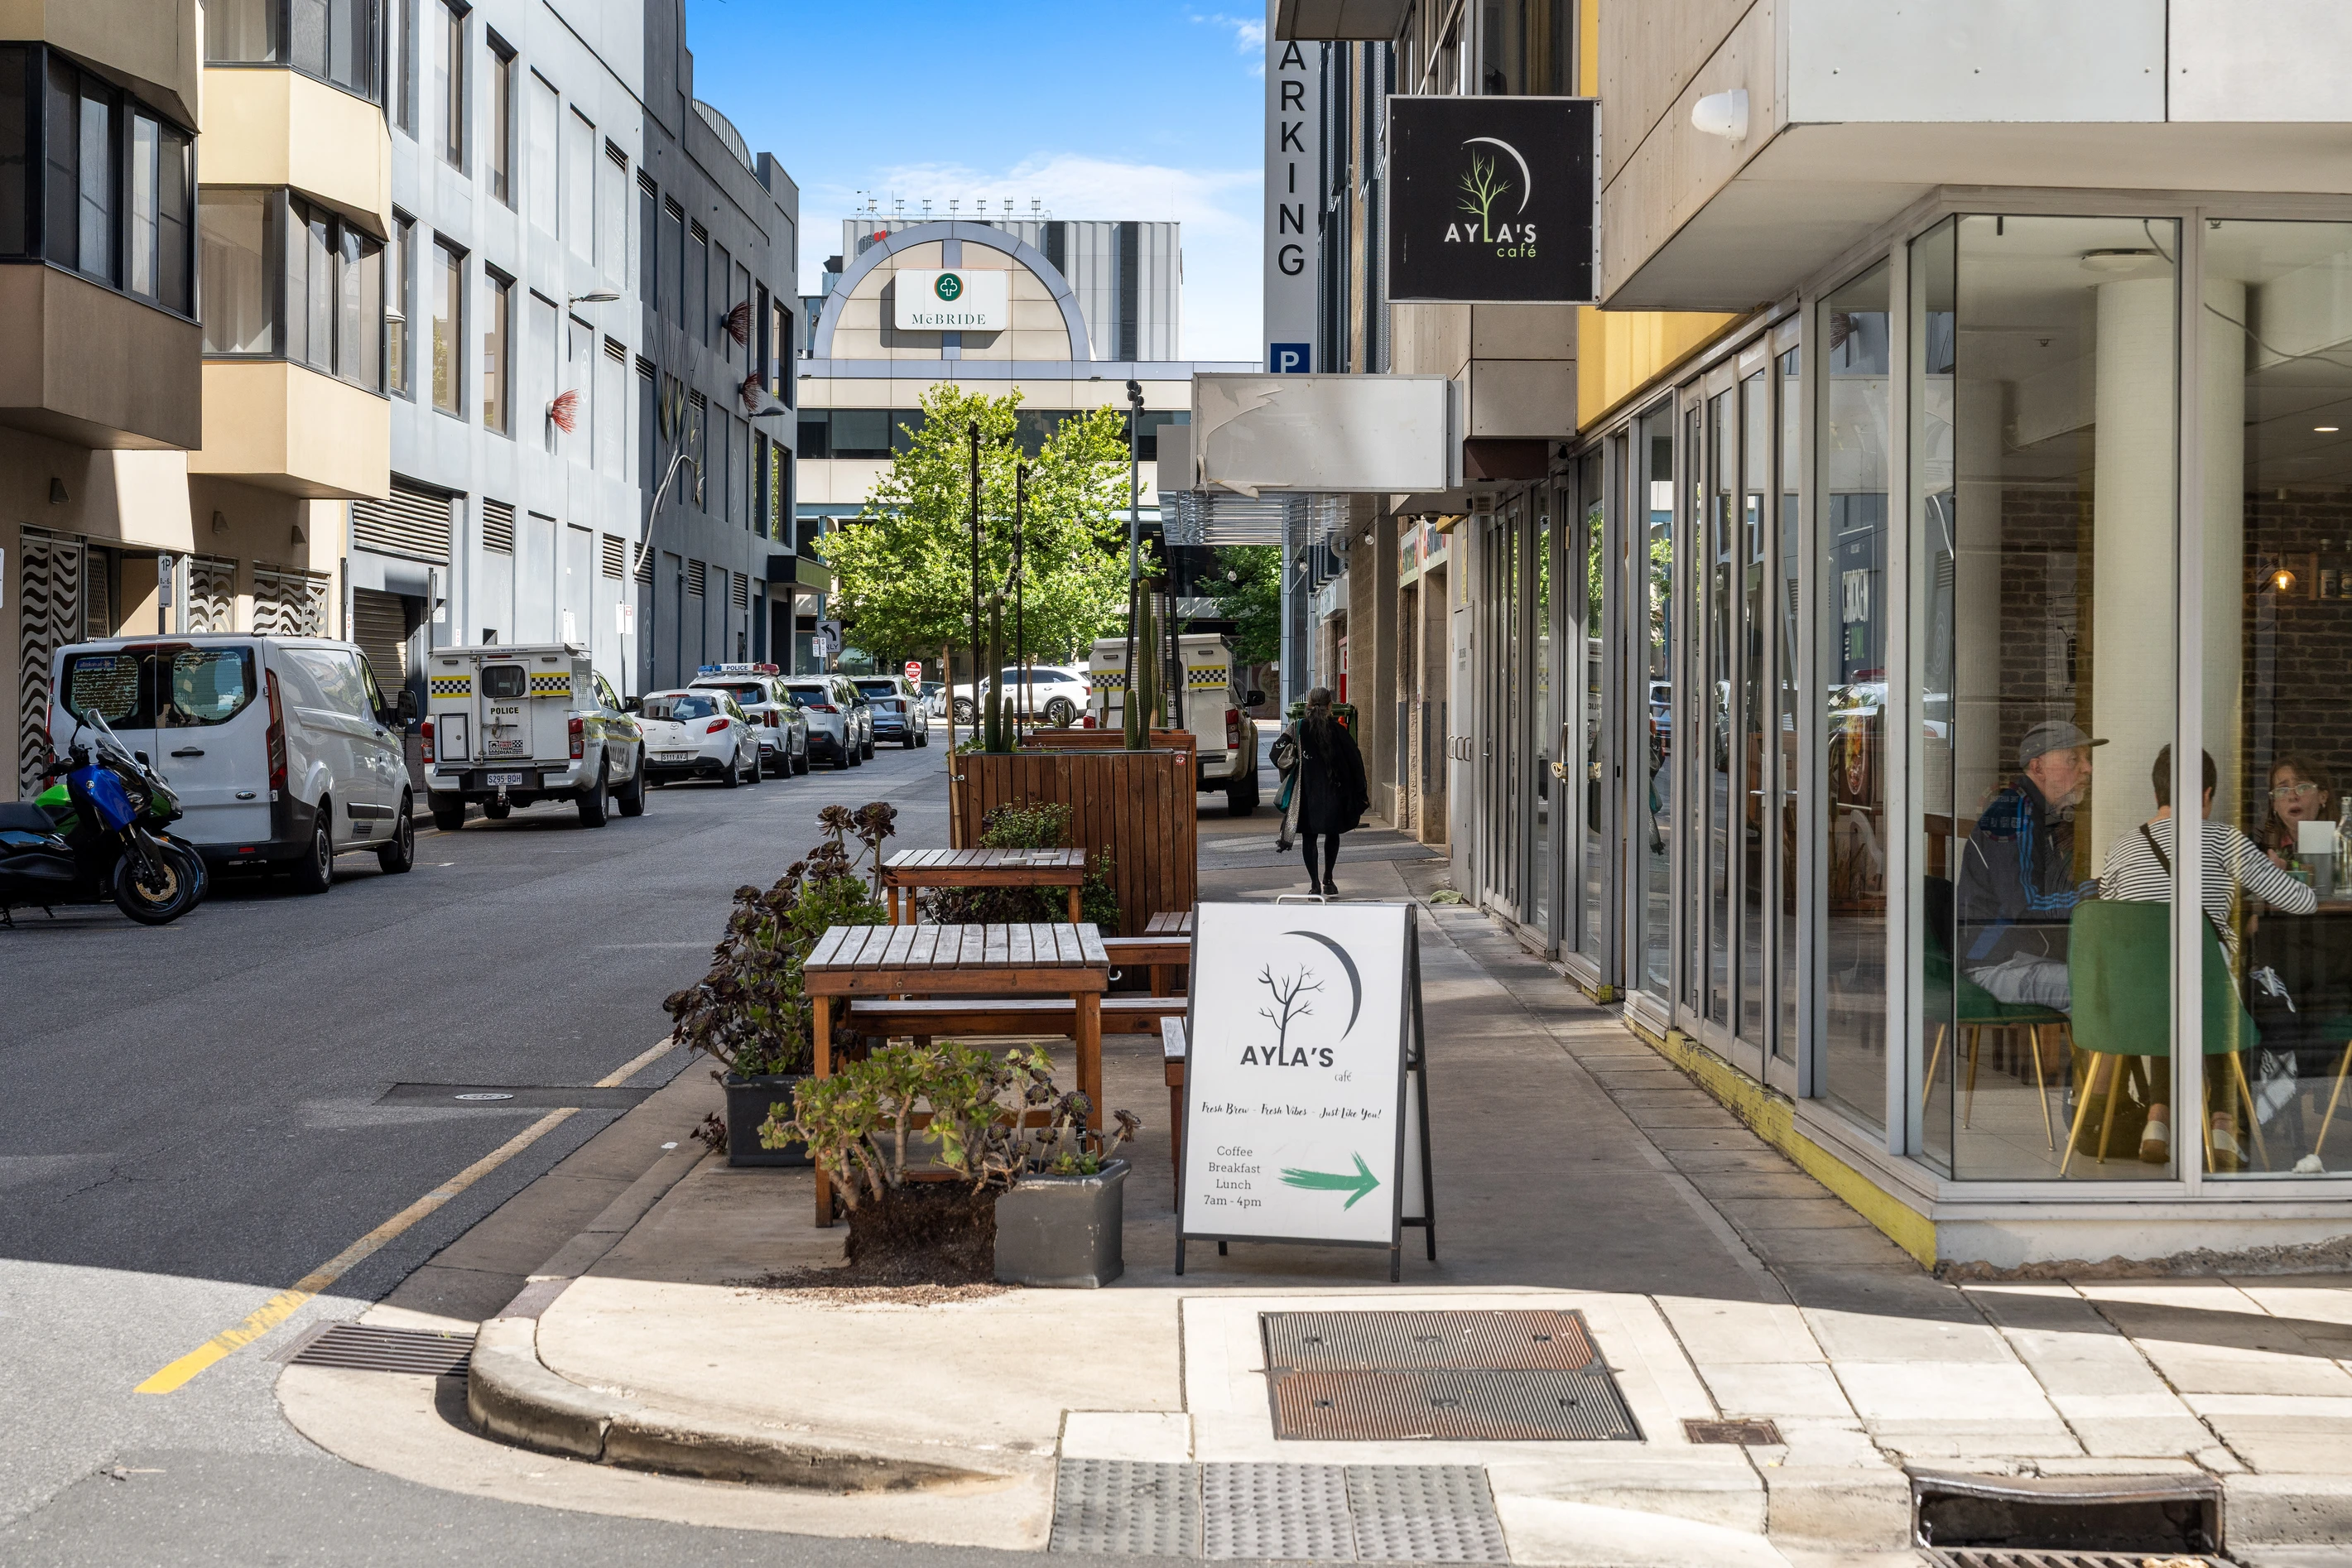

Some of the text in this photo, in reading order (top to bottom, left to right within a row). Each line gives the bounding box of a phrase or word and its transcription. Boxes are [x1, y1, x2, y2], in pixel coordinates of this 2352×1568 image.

[1278, 41, 1306, 276] ARKING
[1444, 223, 1537, 243] AYLA'S
[1497, 243, 1536, 257] café
[911, 313, 986, 325] McBRIDE
[1281, 351, 1299, 373] P
[161, 558, 171, 571] 1P
[1335, 1070, 1352, 1082] café
[1202, 1102, 1223, 1113] Fresh
[1226, 1103, 1248, 1114] Brew
[1261, 1104, 1282, 1115] Fresh
[1286, 1104, 1307, 1116] Vibes
[1319, 1107, 1340, 1118] Just
[1340, 1107, 1357, 1118] Like
[1361, 1108, 1382, 1121] You!
[1217, 1146, 1253, 1157] Coffee
[1209, 1162, 1261, 1174] Breakfast
[1216, 1179, 1252, 1190] Lunch
[1204, 1195, 1227, 1205] 7am
[1237, 1196, 1262, 1209] 4pm
